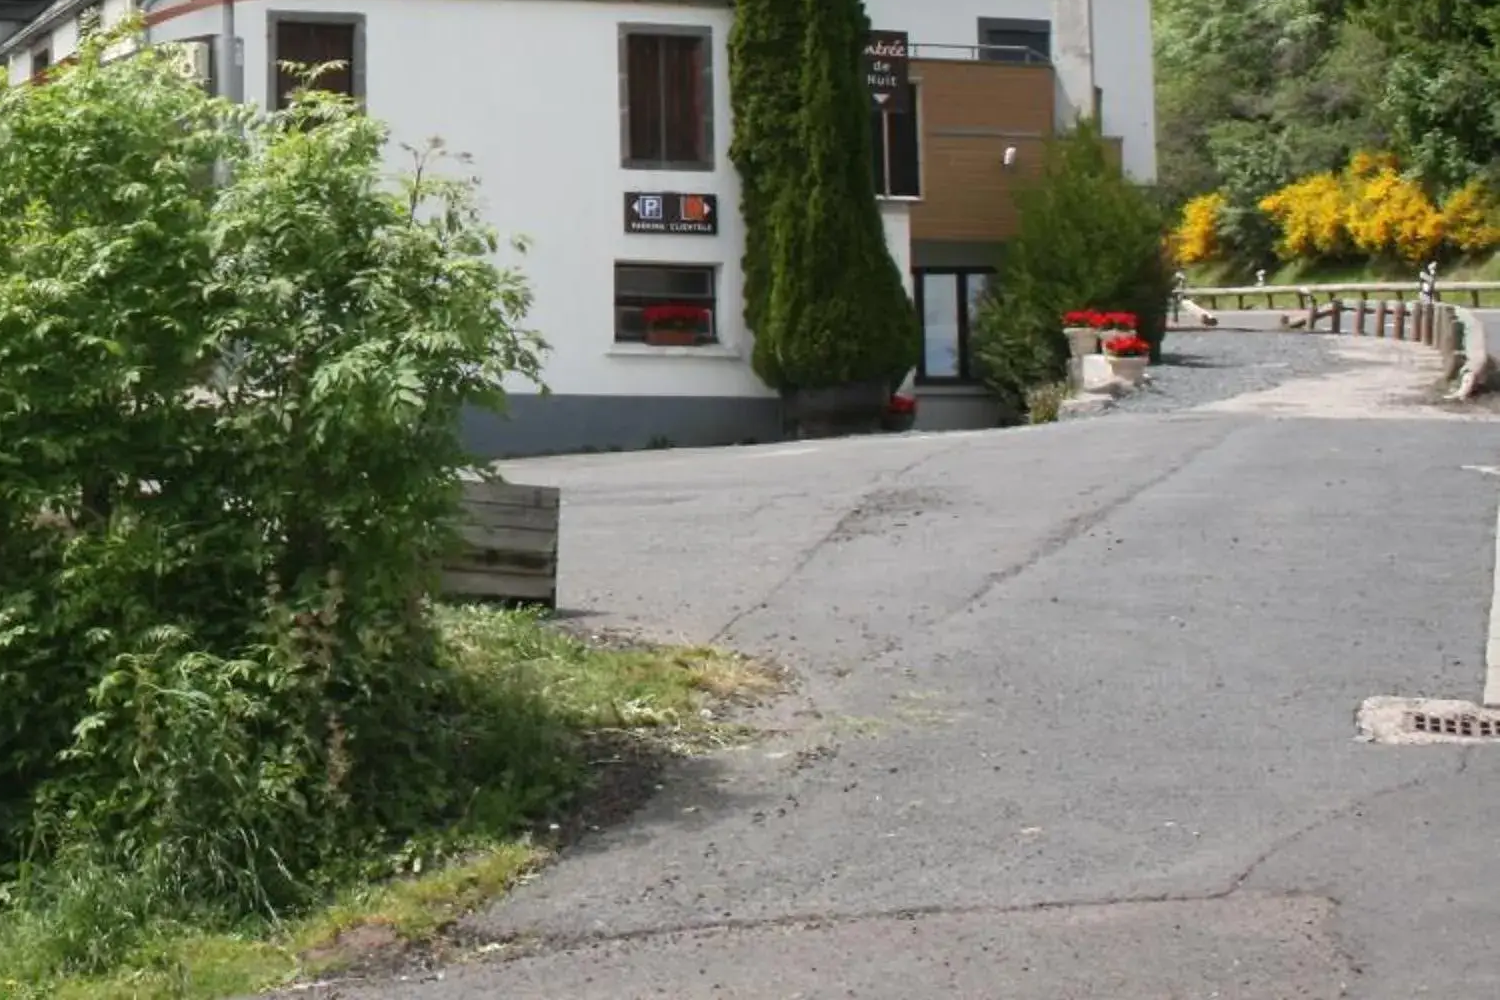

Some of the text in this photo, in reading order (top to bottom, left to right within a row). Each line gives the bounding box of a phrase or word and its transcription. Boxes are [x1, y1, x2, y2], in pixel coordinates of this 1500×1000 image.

[863, 40, 905, 57] ntrée
[873, 60, 891, 72] de
[867, 74, 897, 87] Nuit
